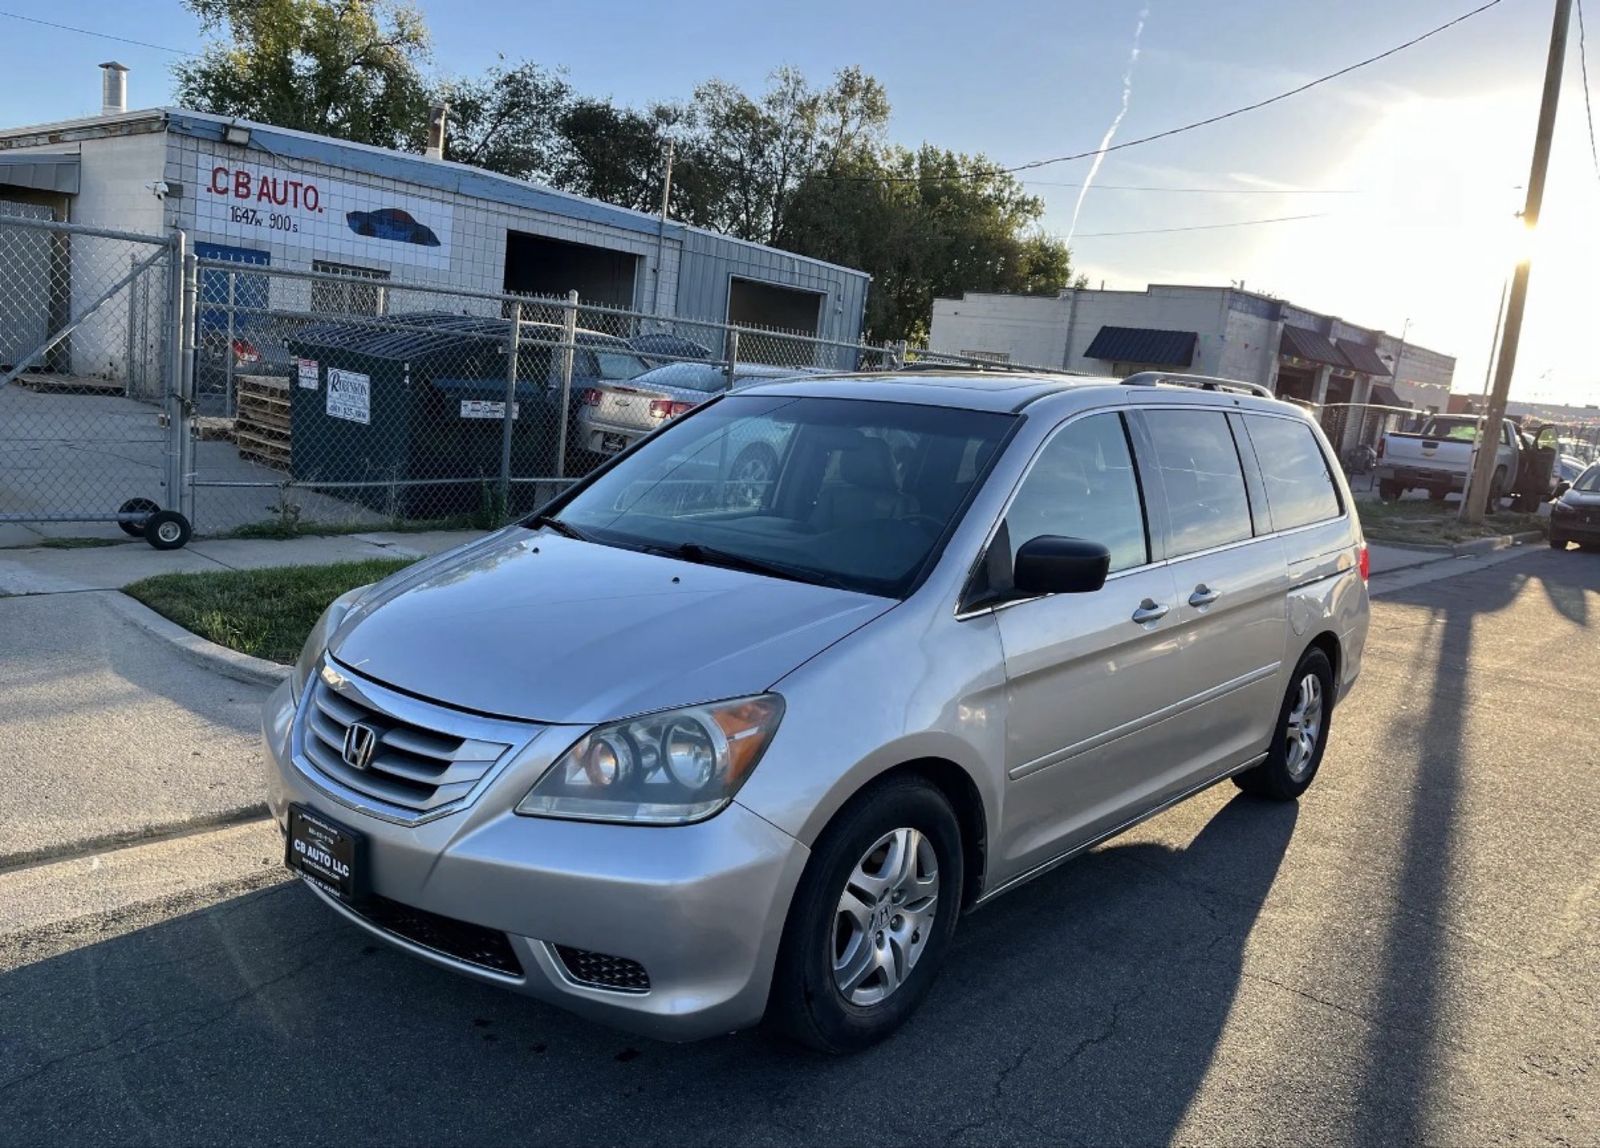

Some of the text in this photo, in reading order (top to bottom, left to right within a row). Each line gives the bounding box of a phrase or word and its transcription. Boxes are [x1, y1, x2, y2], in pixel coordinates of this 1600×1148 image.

[294, 838, 306, 854] CB
[307, 845, 331, 868] AUTO
[332, 858, 350, 877] LLC
